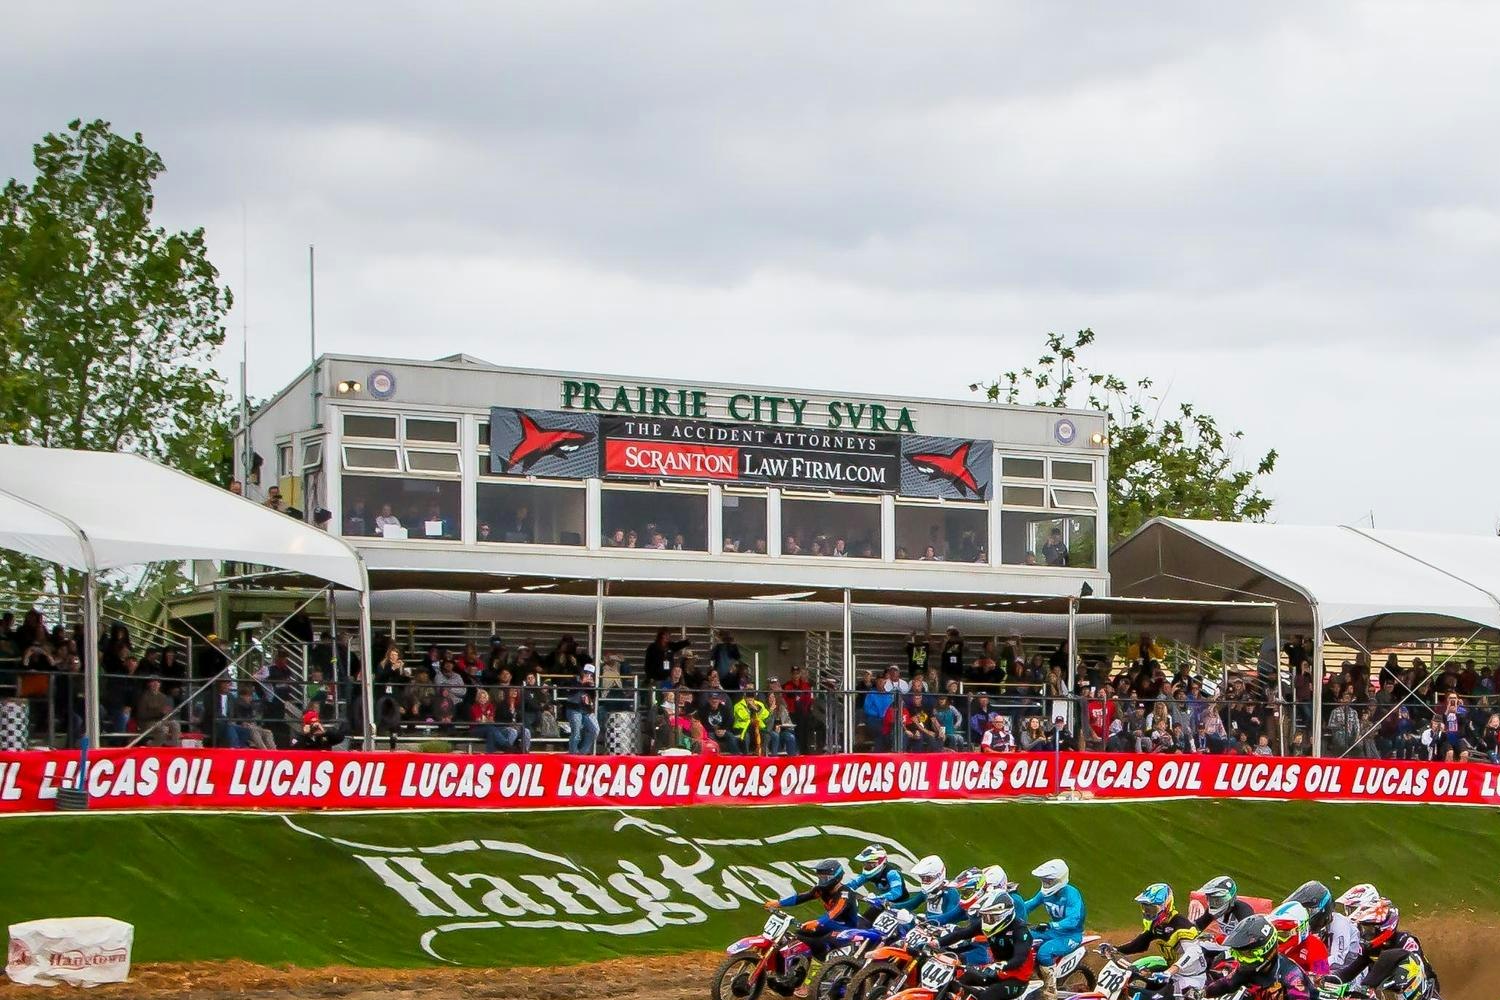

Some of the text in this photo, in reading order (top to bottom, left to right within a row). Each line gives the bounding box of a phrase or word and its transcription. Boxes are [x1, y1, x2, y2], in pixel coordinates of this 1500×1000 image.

[563, 380, 916, 433] PRAIRIE CITY SVRA
[625, 421, 876, 451] THE ACCIDENT ATTORNEYS
[38, 757, 215, 799] LUCAS OIL
[229, 759, 387, 798] LUCAS OIL
[400, 762, 545, 799] LUCAS OIL
[557, 763, 690, 798] LUCAS OIL
[696, 764, 817, 797] LUCAS OIL
[827, 761, 930, 794] LUCAS OIL
[938, 759, 1049, 791] LUCAS OIL
[1059, 759, 1202, 791] LUCAS OIL
[1214, 762, 1342, 793] LUCAS OIL
[1351, 766, 1469, 796] LUCAS OIL
[922, 963, 952, 985] 444
[1098, 970, 1124, 993] 218
